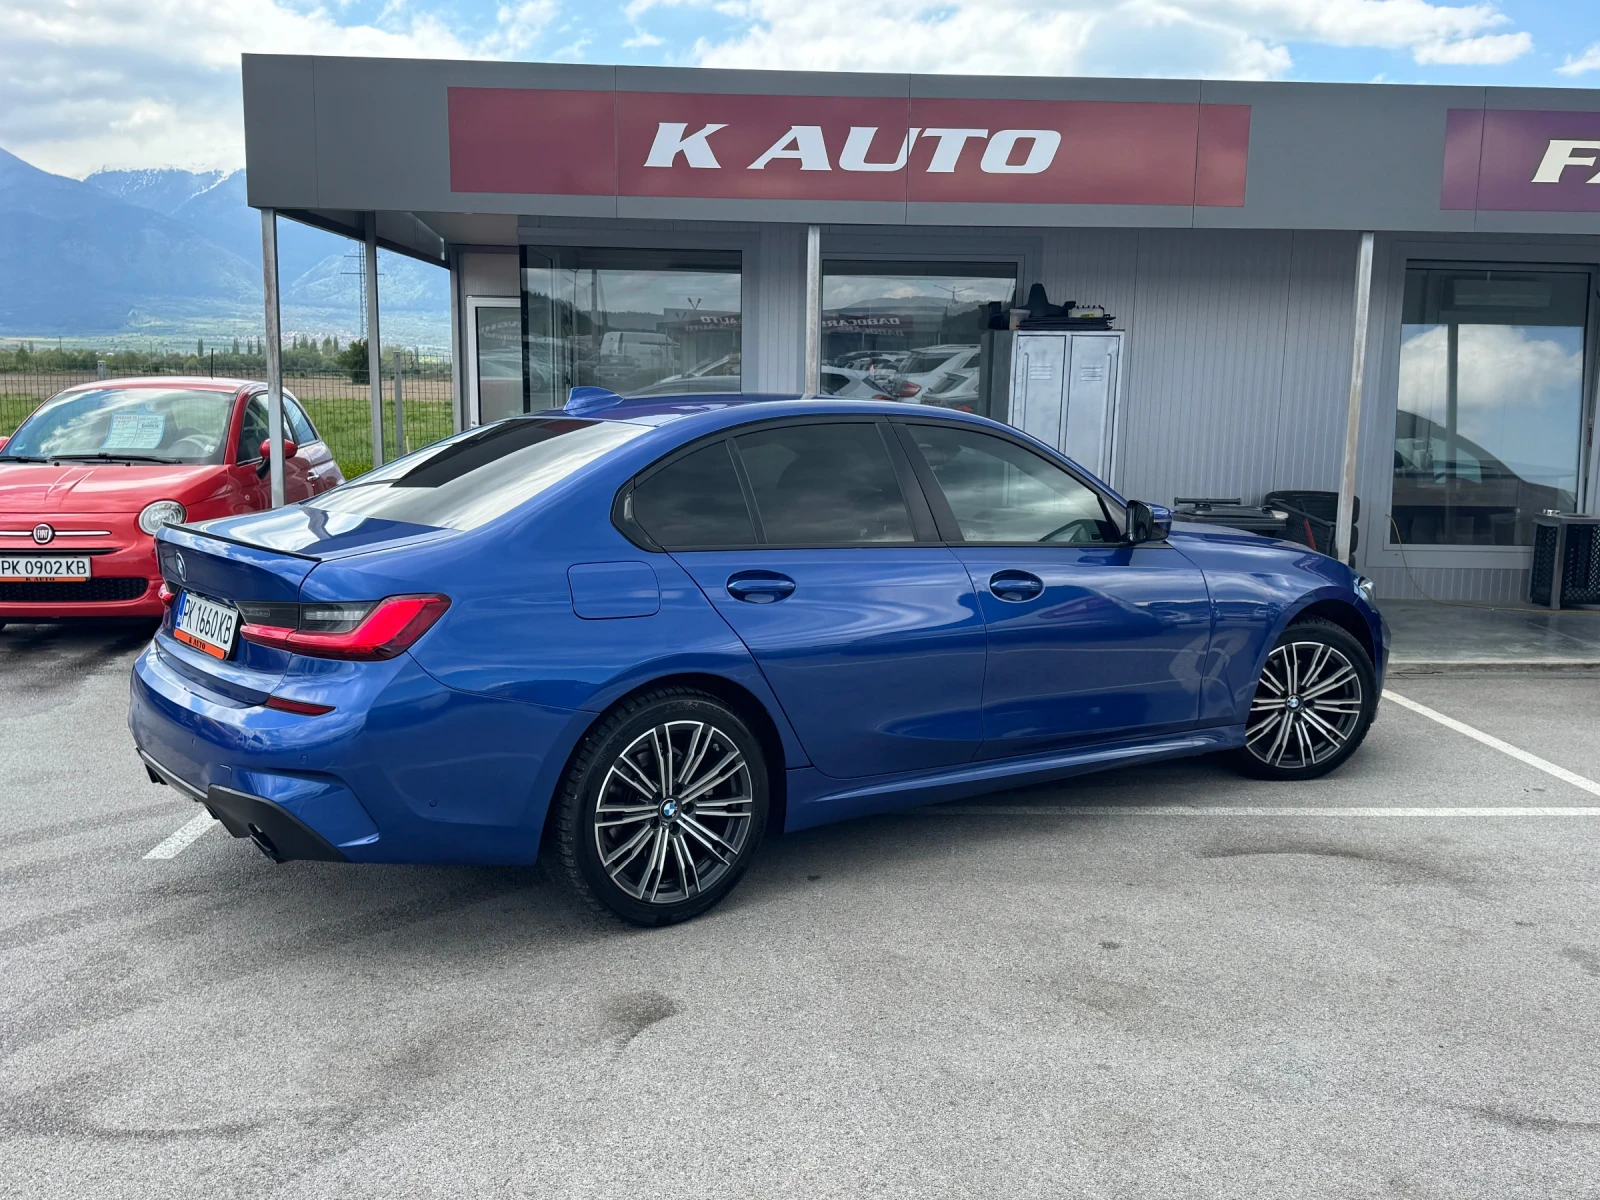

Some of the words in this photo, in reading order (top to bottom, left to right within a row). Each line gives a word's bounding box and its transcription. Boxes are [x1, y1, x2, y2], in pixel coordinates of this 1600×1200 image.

[643, 122, 729, 168] K
[746, 125, 1062, 174] AUTO
[37, 529, 49, 539] FIAT
[1, 560, 21, 575] PK
[25, 560, 63, 575] 0902
[66, 560, 87, 575] KB
[182, 599, 197, 629] PK
[195, 604, 219, 639] 1660
[216, 612, 233, 645] KB
